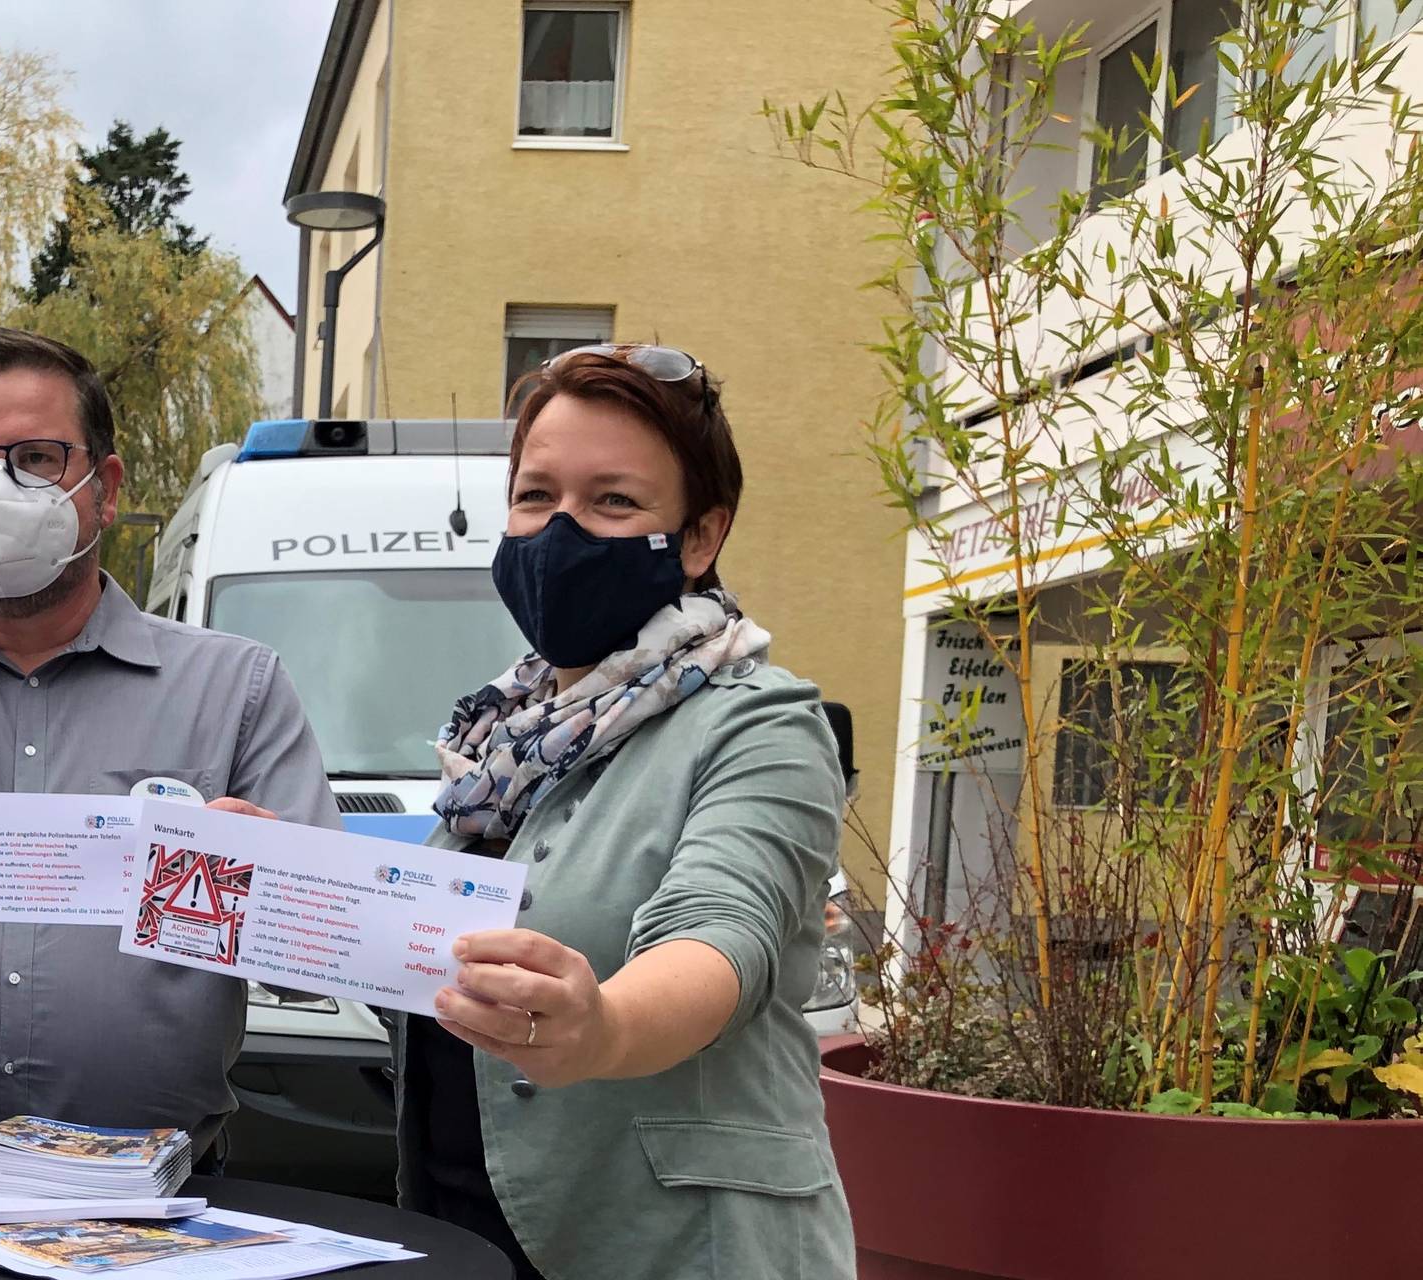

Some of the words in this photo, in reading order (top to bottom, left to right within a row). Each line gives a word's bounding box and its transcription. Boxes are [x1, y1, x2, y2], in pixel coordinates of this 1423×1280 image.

[936, 630, 984, 649] Frisch
[949, 657, 1005, 679] Eifeler
[153, 823, 195, 839] Warnkarte
[403, 870, 433, 881] POLIZEI
[291, 871, 326, 884] angebliche
[327, 878, 376, 893] Polizeibeamte
[390, 890, 416, 900] Telefon
[478, 884, 507, 894] POLIZEI
[282, 894, 329, 909] Überweisungen
[309, 889, 344, 900] Wertsachen
[171, 923, 208, 936] ACHTUNG!
[277, 923, 329, 938] Verschwiegenheit
[412, 923, 444, 936] STOPP!
[303, 942, 337, 955] legitimieren
[408, 941, 435, 954] Sofort
[298, 956, 327, 966] verbinden
[241, 956, 256, 964] Bitte
[257, 960, 286, 972] auflegen
[287, 966, 300, 974] und
[301, 969, 326, 979] danach
[327, 975, 346, 984] selbst
[374, 984, 403, 996] wählen!
[404, 961, 445, 978] auflegen!
